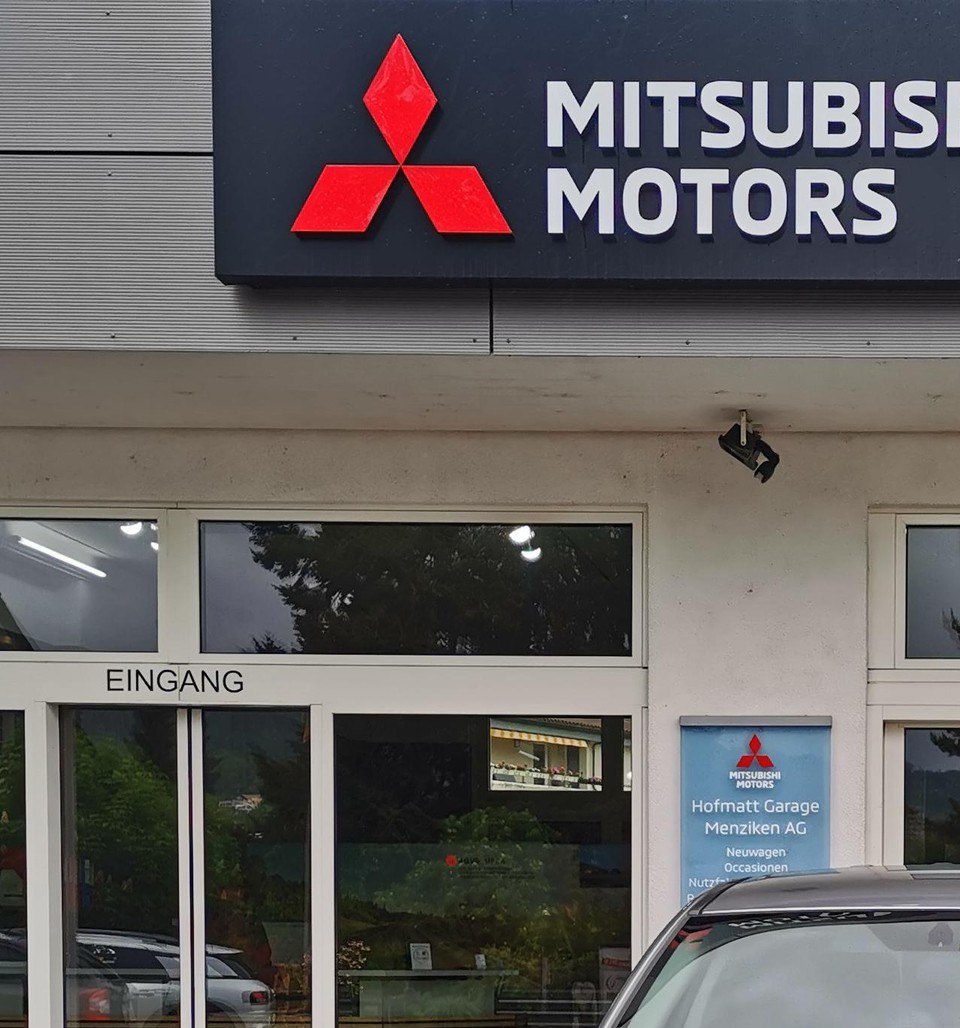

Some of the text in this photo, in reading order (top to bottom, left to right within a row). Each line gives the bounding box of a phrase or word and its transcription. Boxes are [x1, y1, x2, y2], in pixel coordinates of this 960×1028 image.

[546, 167, 898, 236] MOTORS
[107, 669, 244, 693] EINGANG
[729, 771, 781, 780] MITSUBISHI
[736, 780, 774, 789] MOTORS
[692, 799, 820, 816] Hofmatt Garage
[705, 821, 807, 835] Menziken AG
[726, 847, 786, 860] Neuwagen
[724, 862, 788, 873] Occasionen
